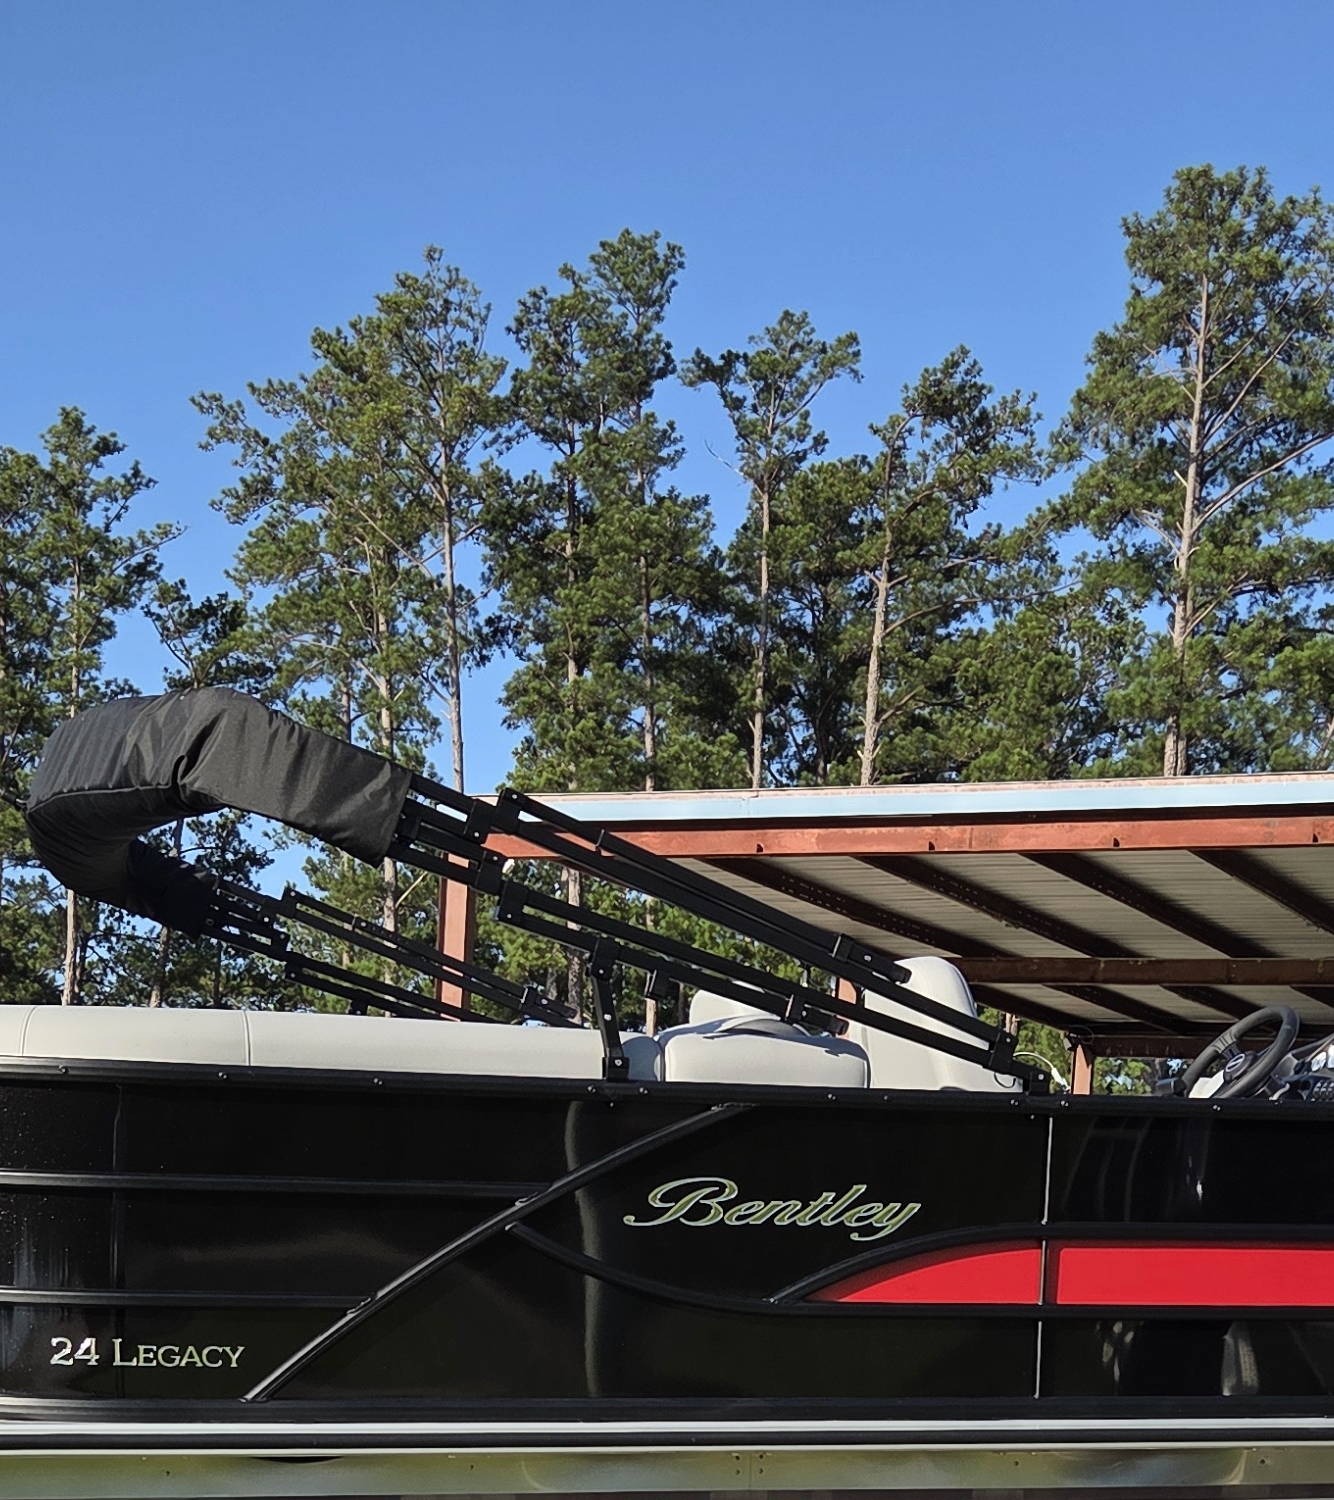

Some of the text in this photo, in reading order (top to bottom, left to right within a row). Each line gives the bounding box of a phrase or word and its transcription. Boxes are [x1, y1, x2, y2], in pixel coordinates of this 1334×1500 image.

[623, 1176, 921, 1241] Bentley
[50, 1336, 245, 1368] 24 LEGACY
